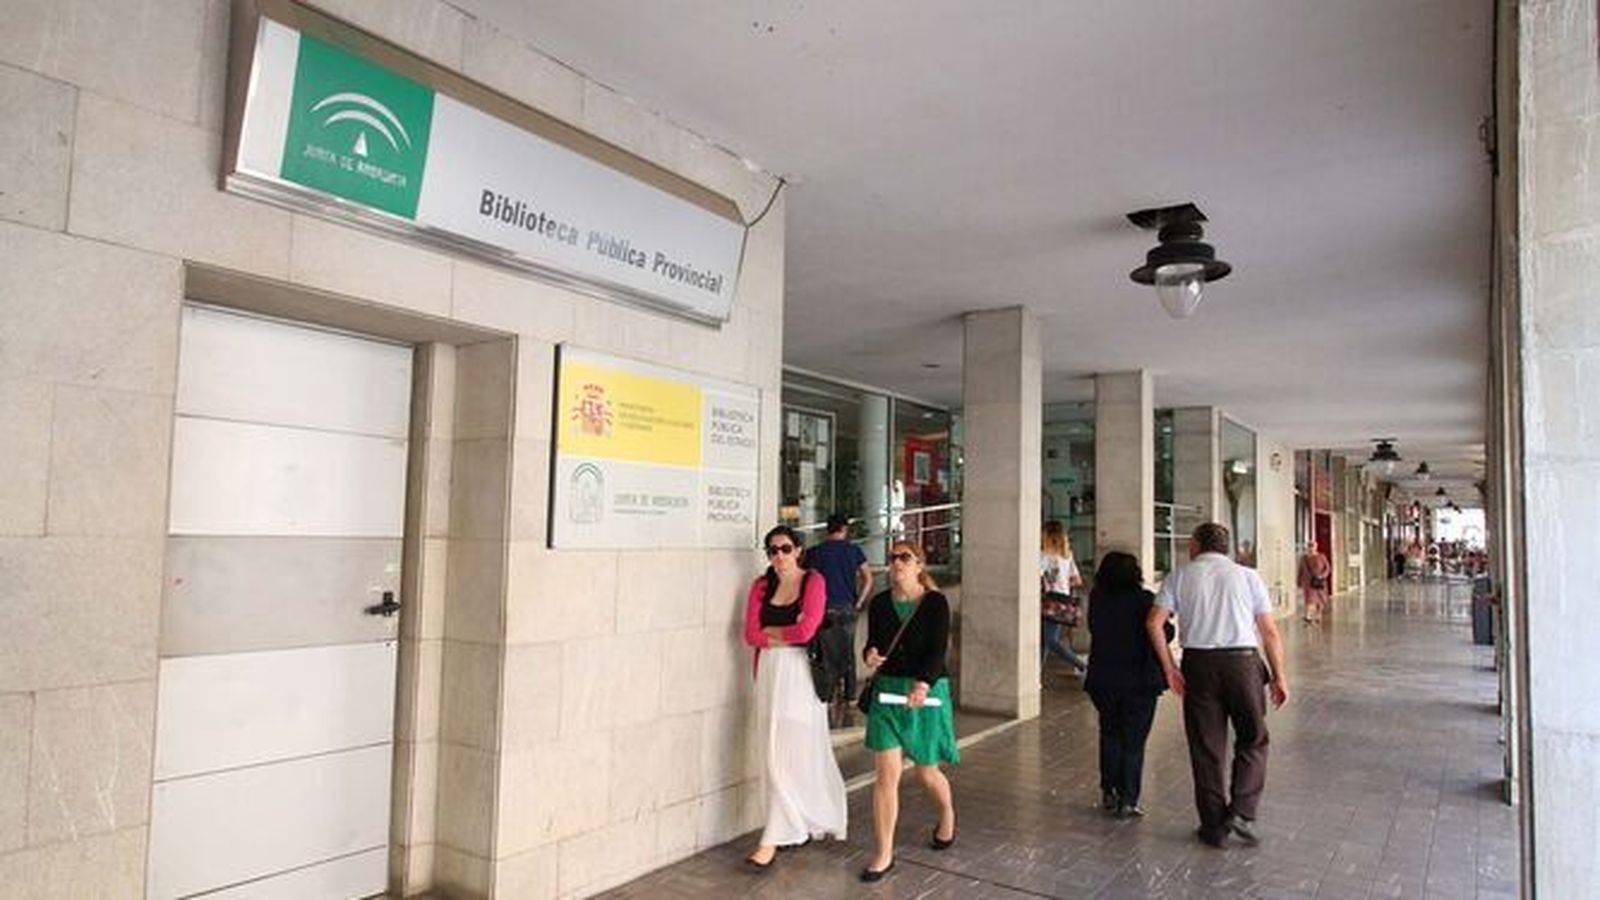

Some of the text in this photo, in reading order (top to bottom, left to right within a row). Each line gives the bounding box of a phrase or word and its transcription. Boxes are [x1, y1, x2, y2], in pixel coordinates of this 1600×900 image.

[340, 155, 355, 171] DE
[479, 188, 579, 246] Biblioteca
[651, 250, 724, 295] Provincial
